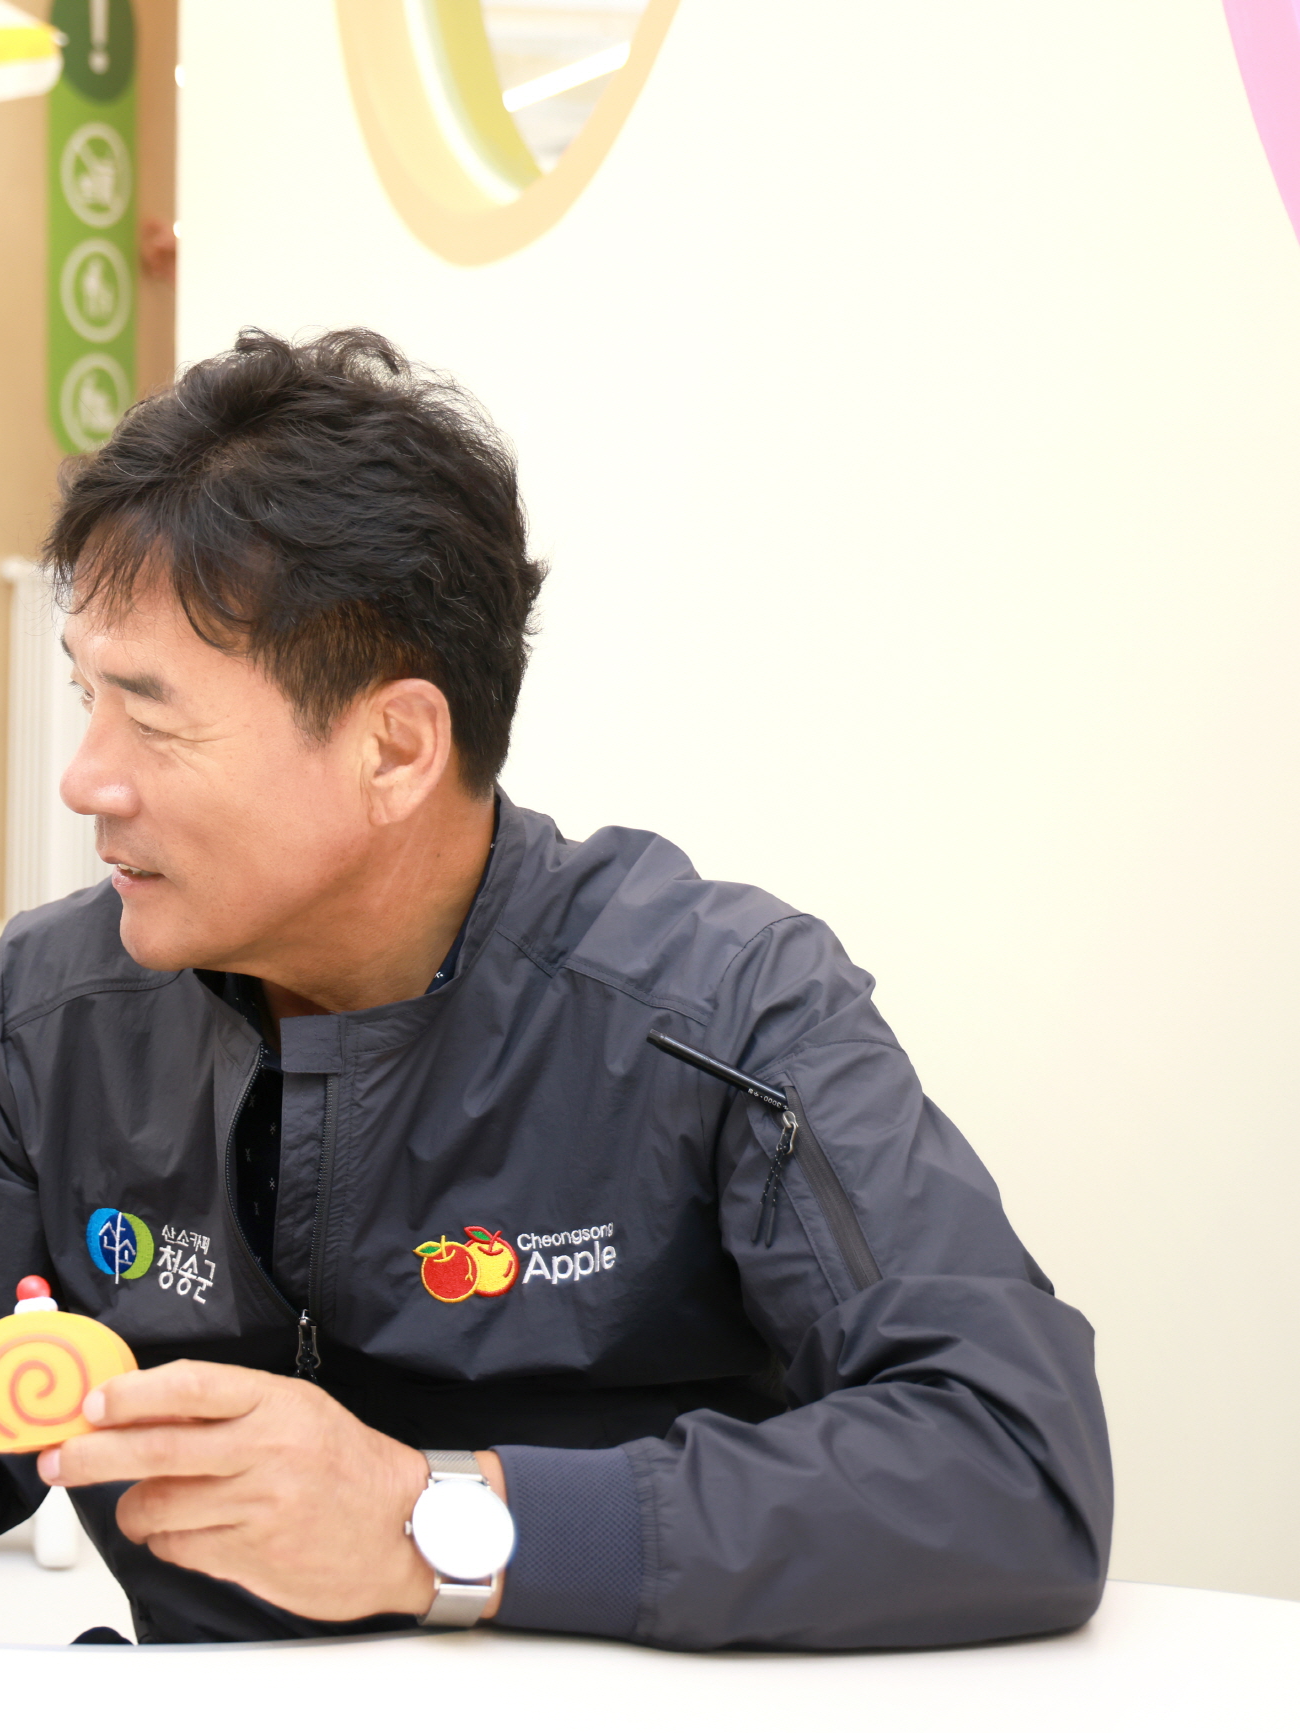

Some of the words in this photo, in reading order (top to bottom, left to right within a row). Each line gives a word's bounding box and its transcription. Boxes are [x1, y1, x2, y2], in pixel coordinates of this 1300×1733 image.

[516, 1222, 614, 1250] Cheongsong
[156, 1245, 216, 1305] 청송군
[521, 1241, 617, 1285] Apple
